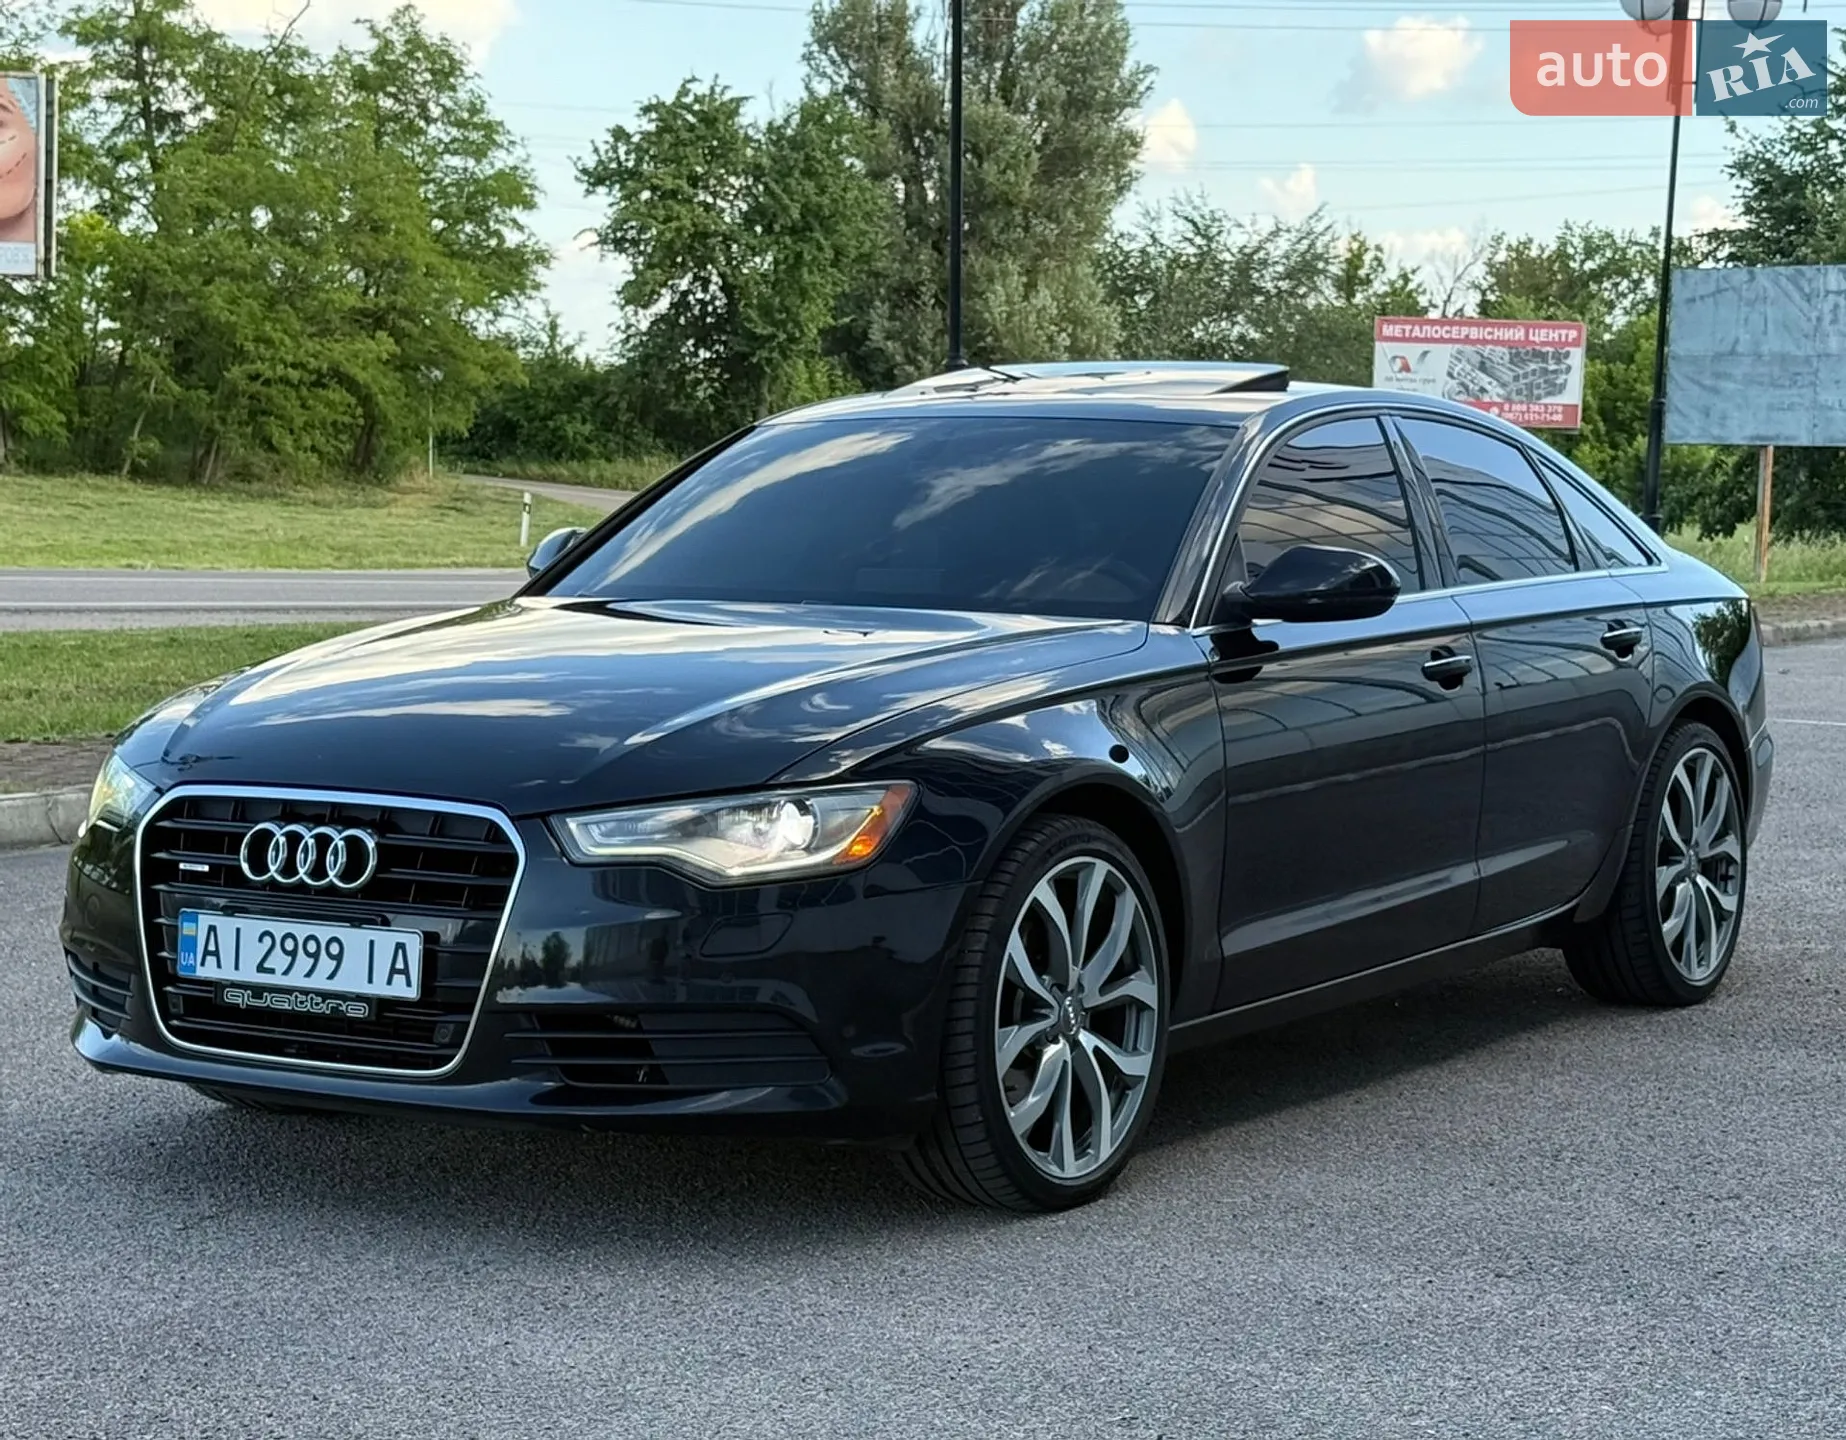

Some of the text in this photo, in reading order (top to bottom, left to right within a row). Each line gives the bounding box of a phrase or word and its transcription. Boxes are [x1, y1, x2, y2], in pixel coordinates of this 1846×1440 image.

[1381, 323, 1578, 344] МЕТАЛОСЕРВІСНИЙ ЦЕНТР
[181, 951, 195, 967] UA
[199, 924, 412, 988] AI 2999 IA
[223, 988, 370, 1018] quattro
